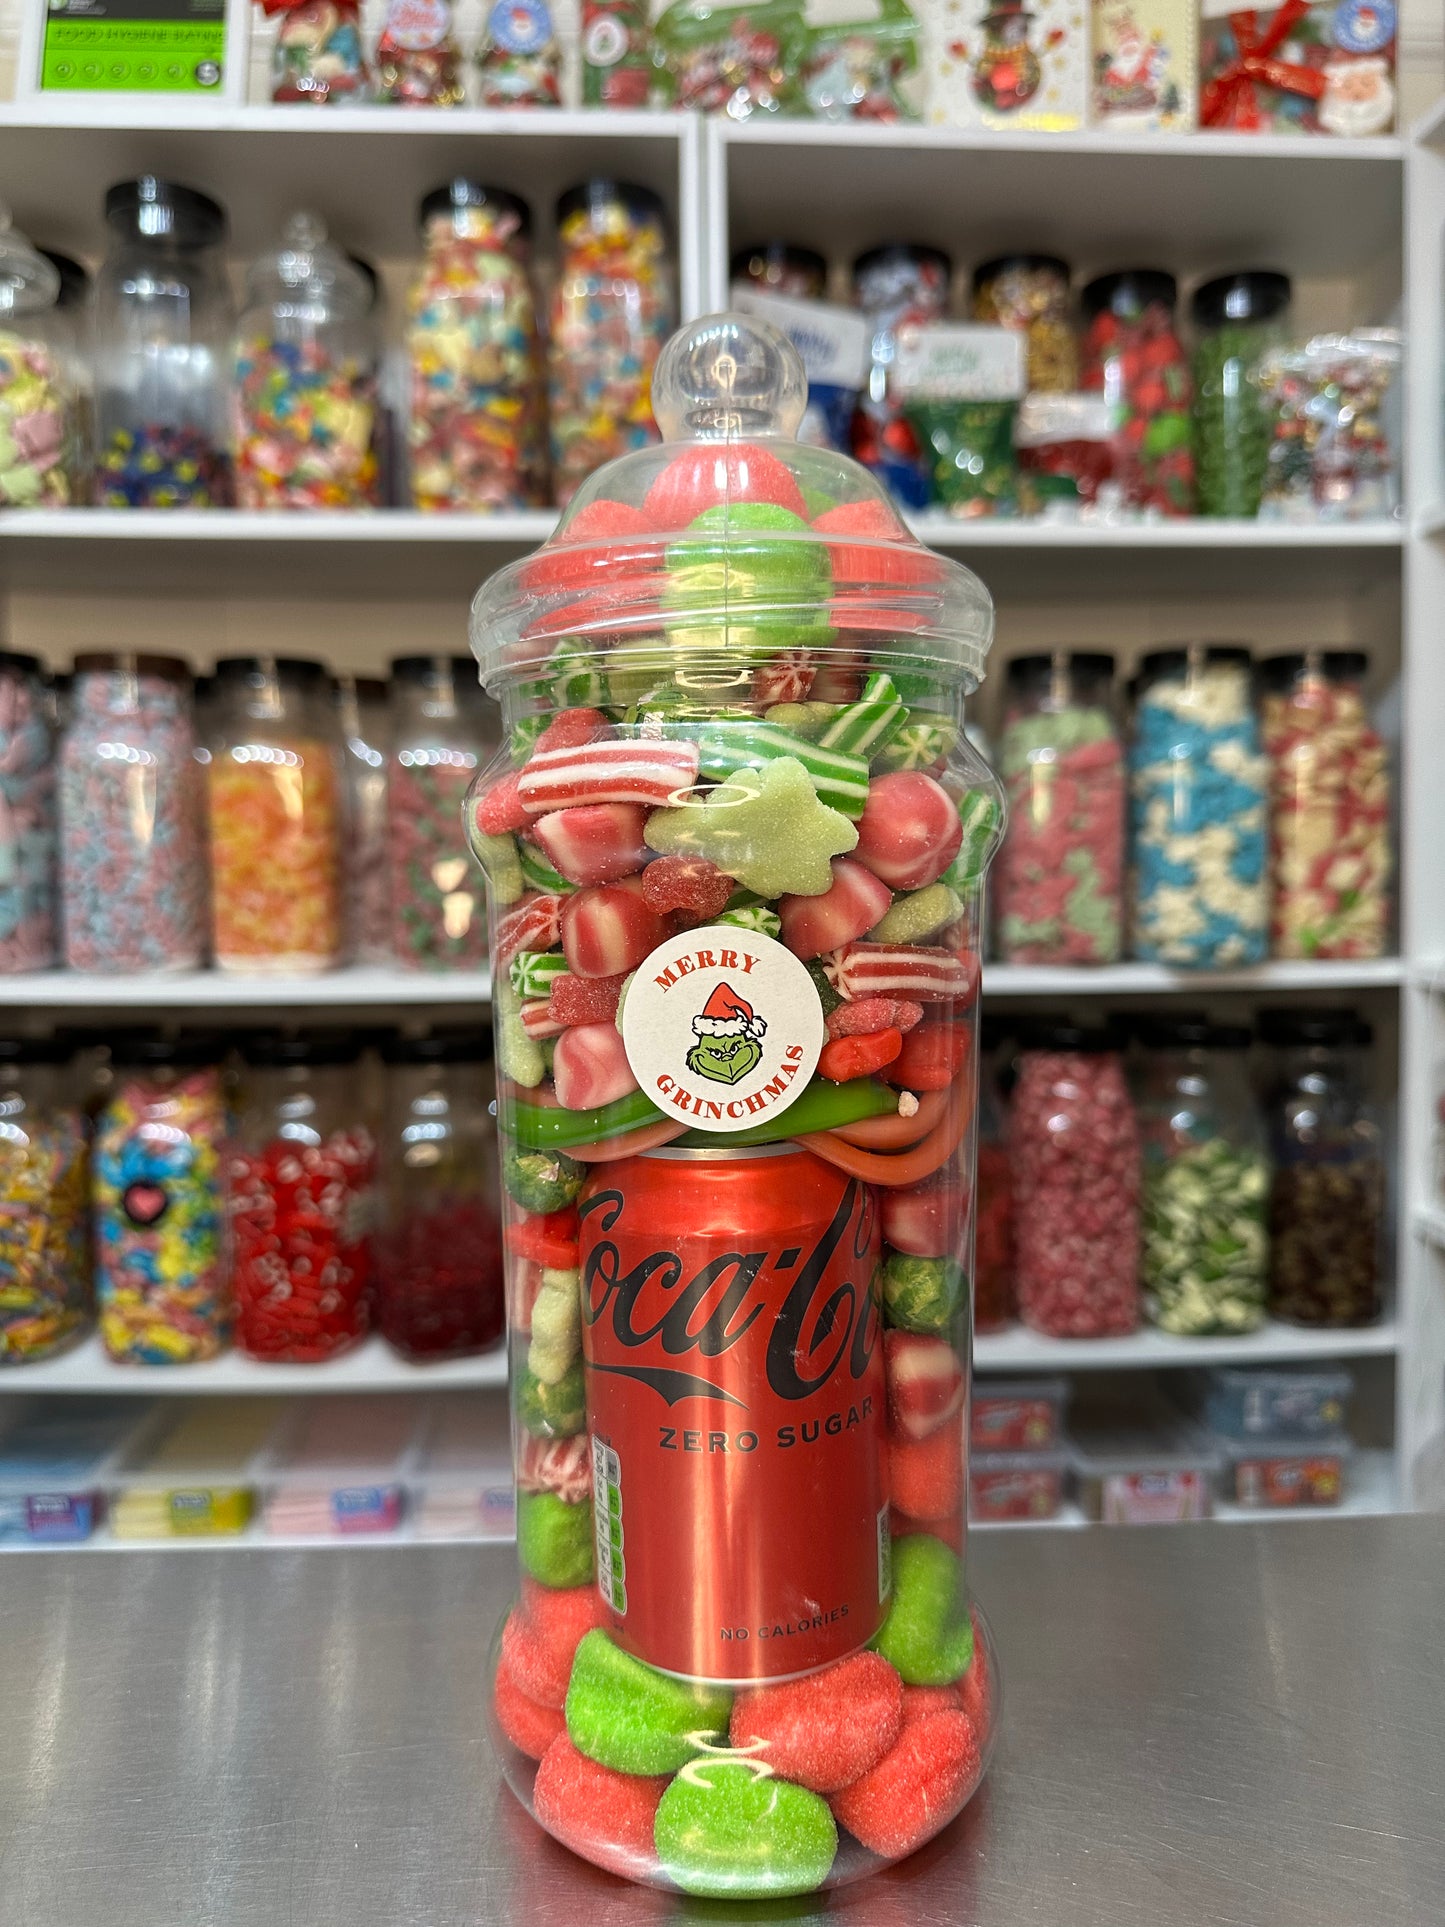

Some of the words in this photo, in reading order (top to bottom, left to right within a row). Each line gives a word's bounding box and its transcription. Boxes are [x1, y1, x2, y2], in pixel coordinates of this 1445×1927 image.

[653, 949, 761, 993] MERRY
[656, 1045, 804, 1119] GRINCHMAS
[659, 1426, 759, 1453] ZERO
[777, 1396, 873, 1448] SUGAR
[720, 1627, 750, 1641] NO
[758, 1604, 849, 1639] CALORIES
